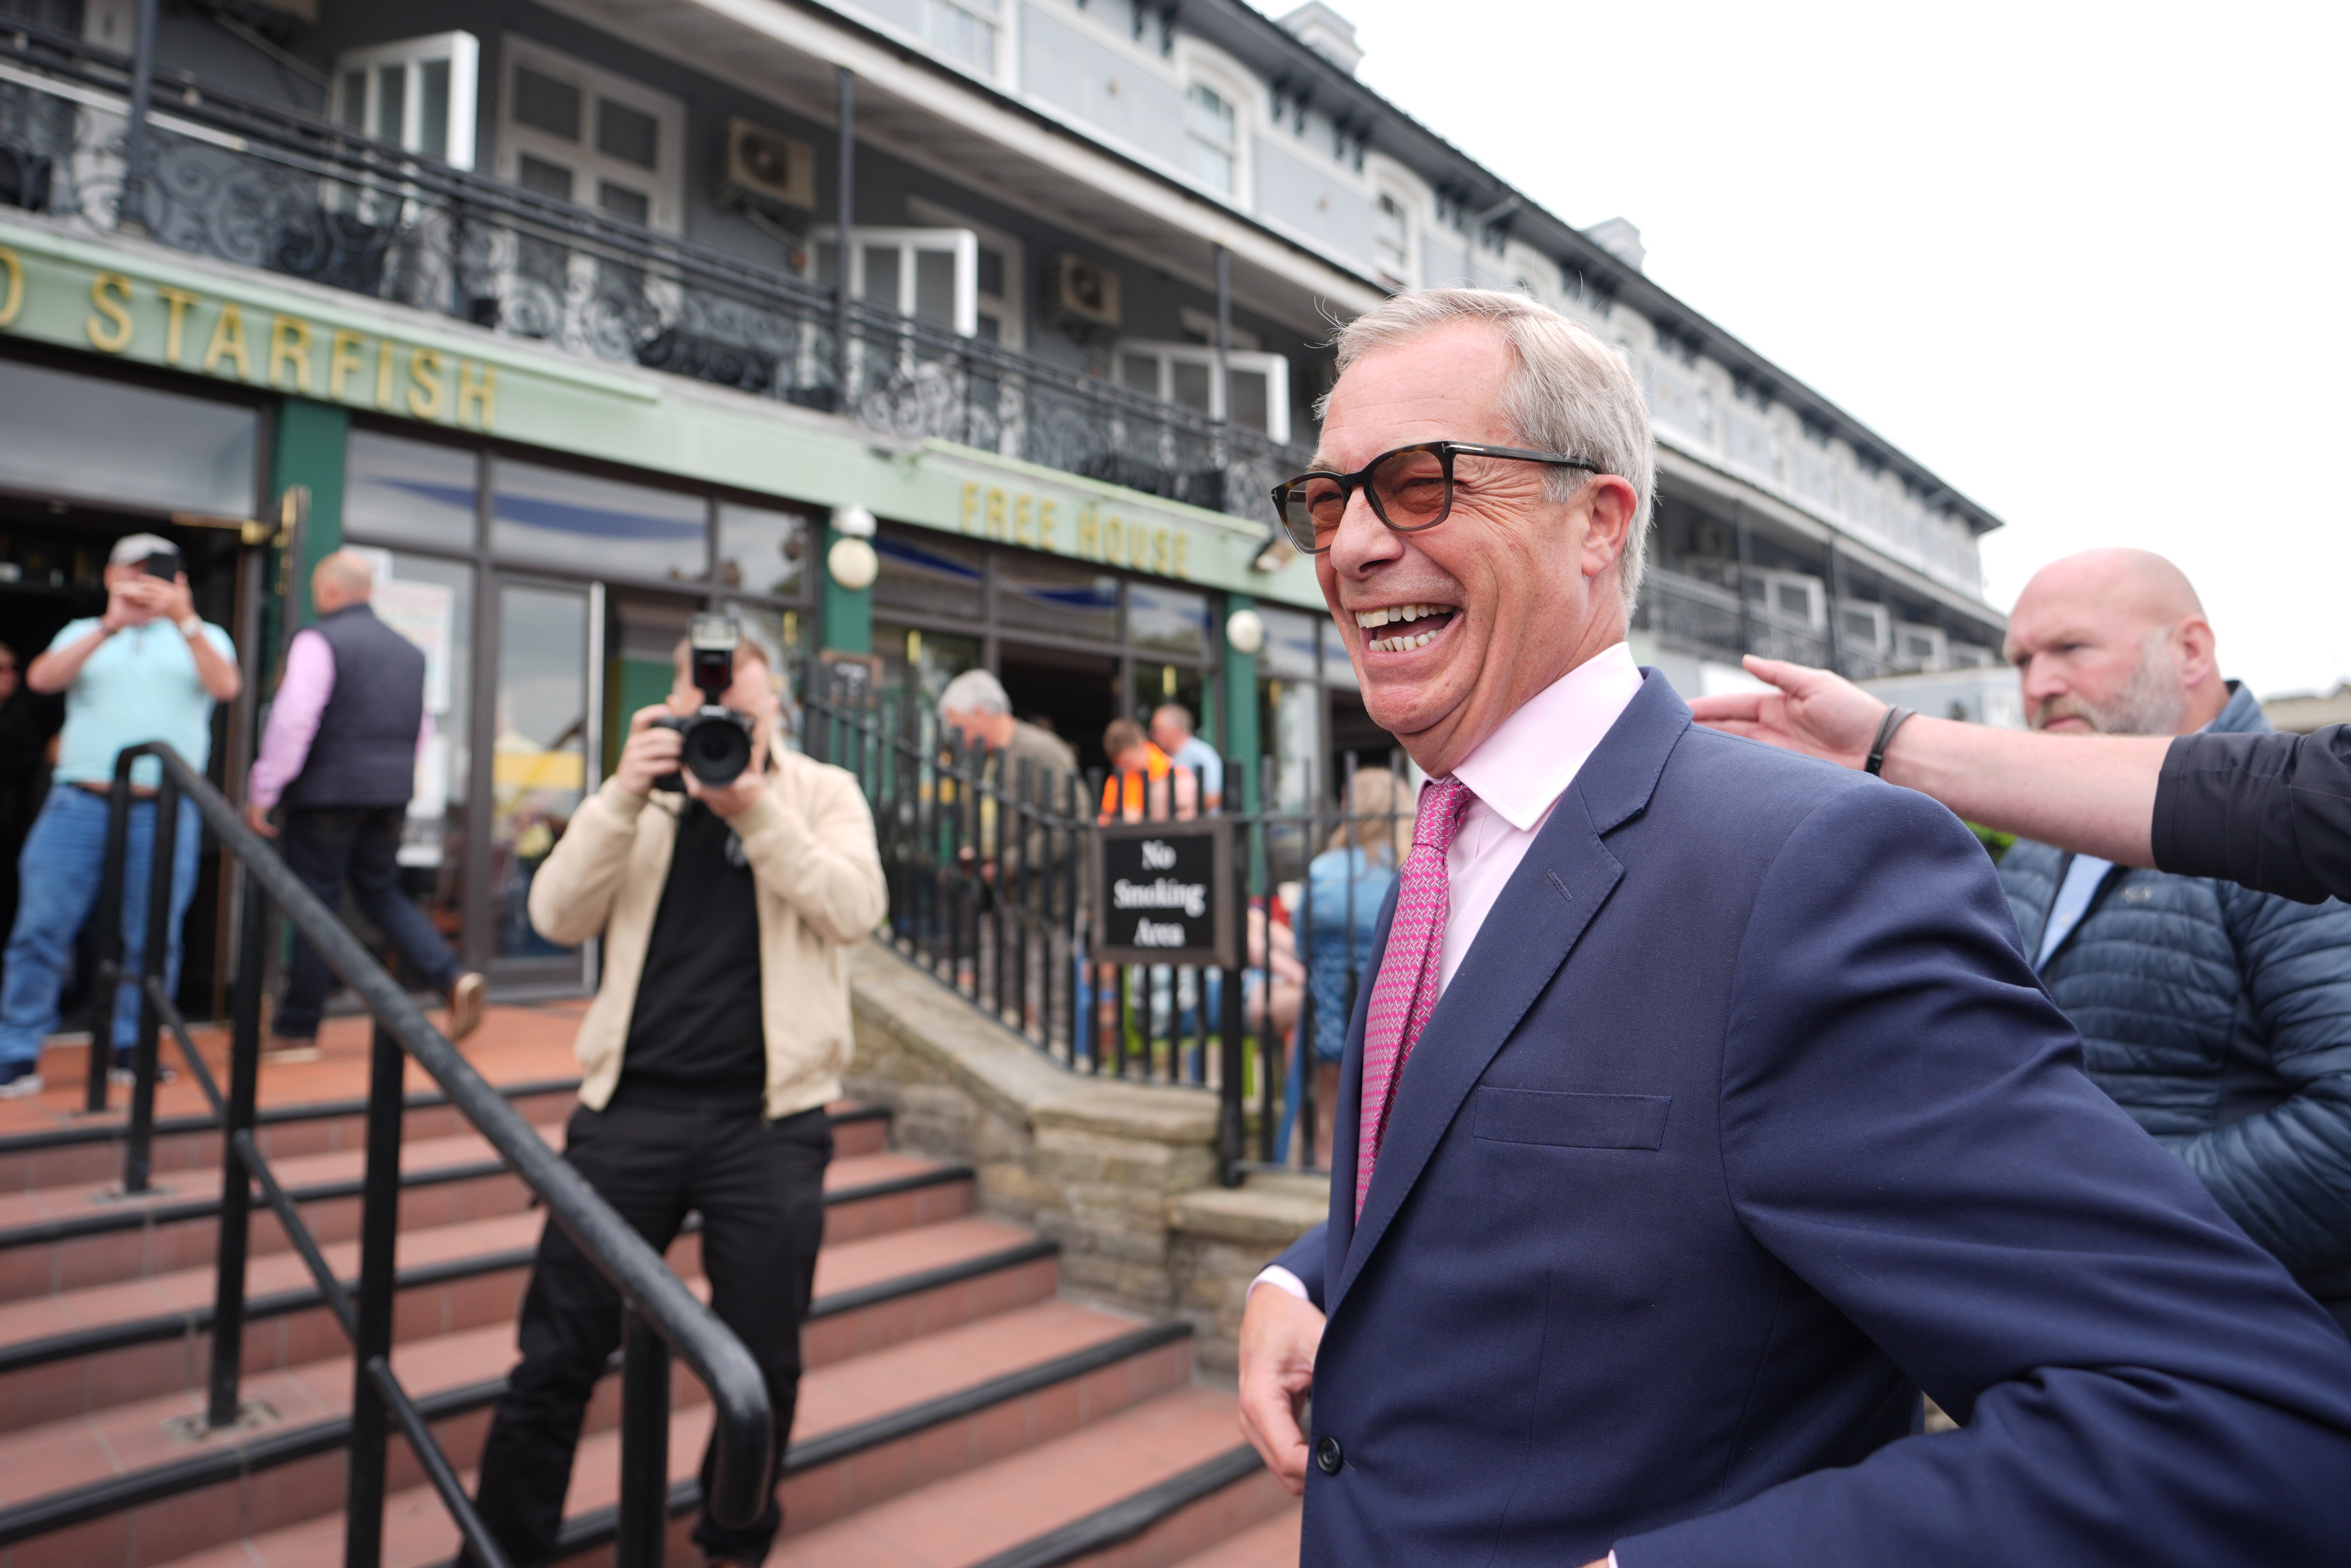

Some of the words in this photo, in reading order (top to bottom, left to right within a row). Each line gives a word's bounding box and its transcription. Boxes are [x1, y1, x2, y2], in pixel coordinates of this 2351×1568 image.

[87, 272, 496, 429] STARFISH
[962, 480, 1057, 551] FREE
[1078, 507, 1188, 577] HOUSE
[1141, 840, 1177, 871] No
[1113, 877, 1206, 918] Smoking
[1133, 916, 1186, 947] Area
